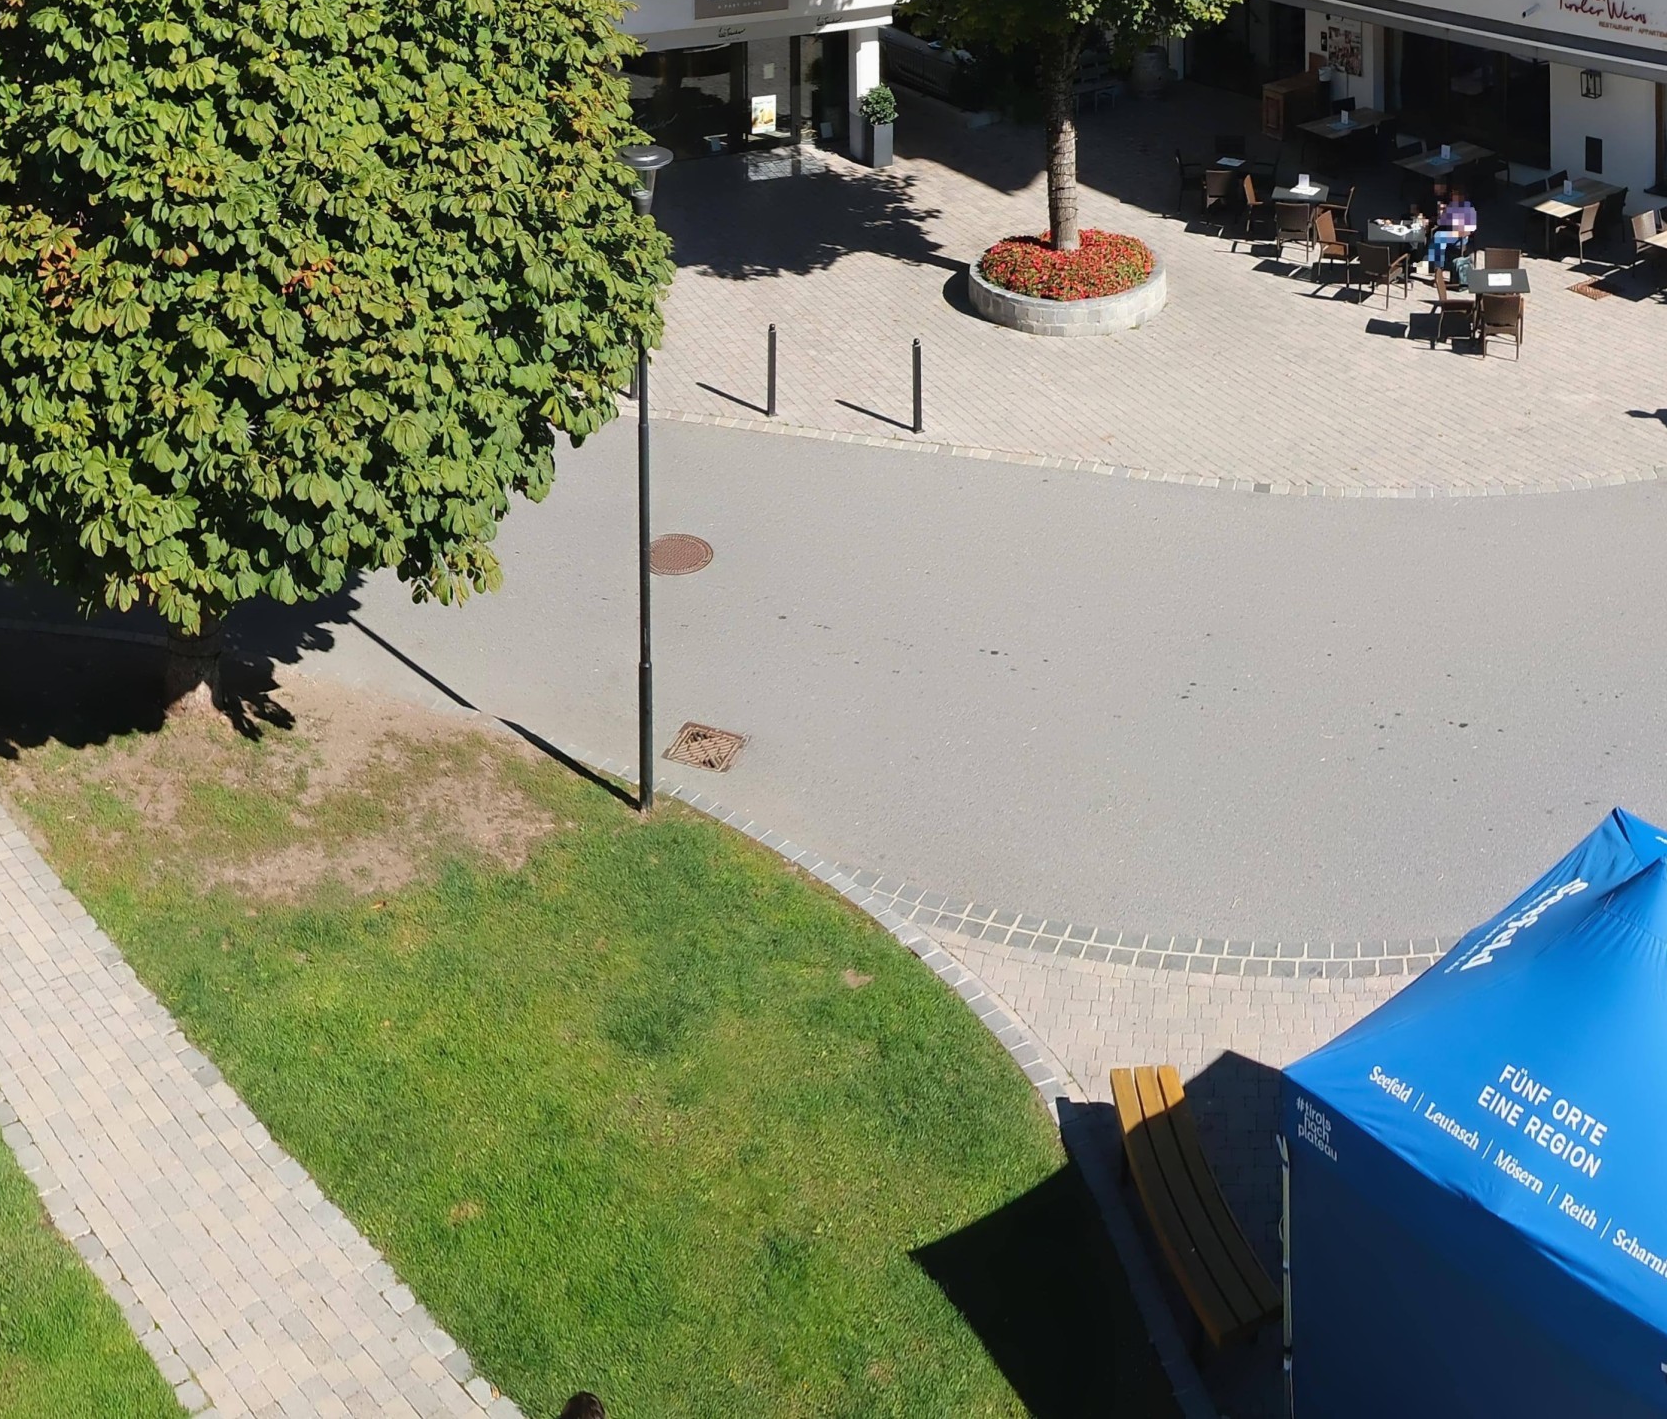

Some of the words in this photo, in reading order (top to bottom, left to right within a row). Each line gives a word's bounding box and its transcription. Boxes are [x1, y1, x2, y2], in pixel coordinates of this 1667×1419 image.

[1598, 21, 1634, 33] RESTAURANT
[1295, 1095, 1332, 1132] #tirols
[1498, 1063, 1552, 1108] FÜNF
[1551, 1097, 1608, 1147] ORTE
[1297, 1123, 1339, 1163] plateau
[1303, 1114, 1331, 1141] hoch
[1477, 1084, 1520, 1128] EINE
[1523, 1116, 1603, 1179] REGION
[1369, 1064, 1413, 1104] Seefeld
[1424, 1101, 1481, 1152] Leutasch
[1492, 1148, 1545, 1195] Mösern
[1558, 1192, 1598, 1232] Reith
